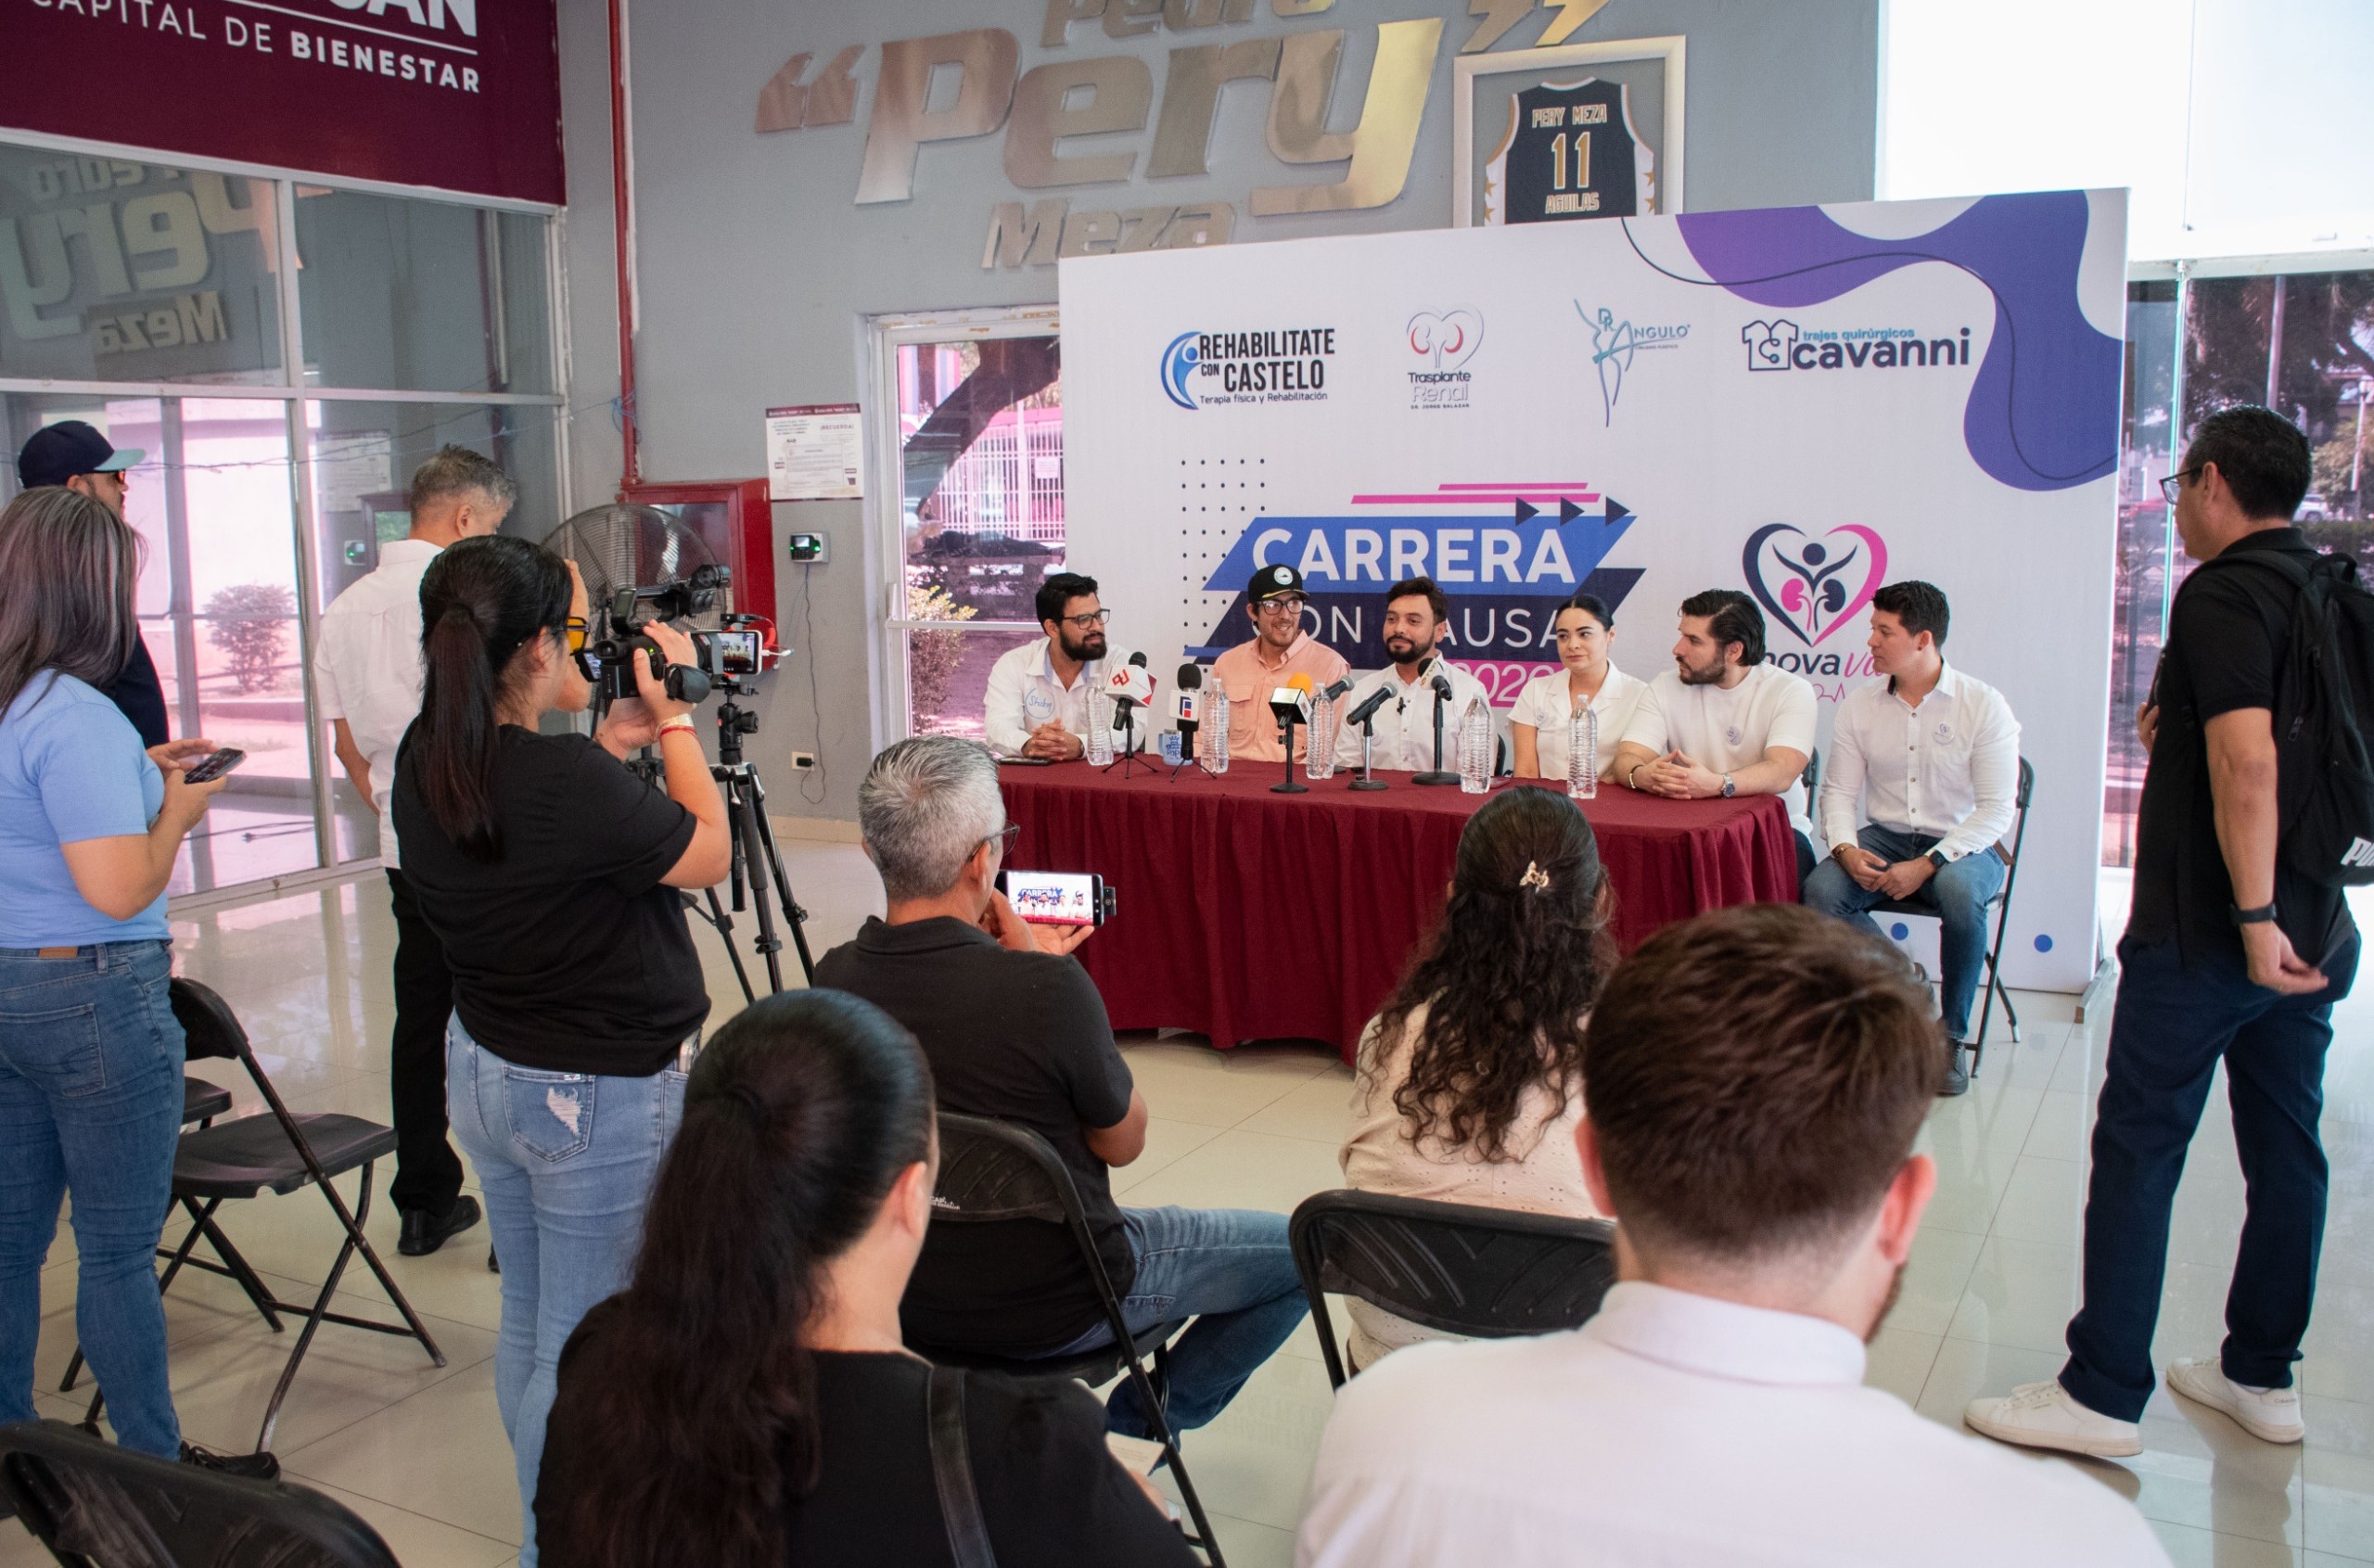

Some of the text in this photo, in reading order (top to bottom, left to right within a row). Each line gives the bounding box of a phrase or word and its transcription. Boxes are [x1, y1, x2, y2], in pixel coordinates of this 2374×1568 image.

[33, 0, 479, 94] PITAL DE BIENESTAR
[1531, 103, 1608, 129] PERY MEZA
[1551, 131, 1591, 189] 11
[1544, 192, 1601, 214] AGUILAS
[981, 198, 1236, 270] Meza
[1199, 327, 1335, 361] REHABILITATE
[1792, 327, 1971, 370] cavanni
[1803, 327, 1915, 342] trajes quirúrgicos
[1201, 359, 1325, 393] CON CASTELO
[1408, 371, 1471, 385] Trasplante
[1412, 383, 1469, 402] Renal
[1200, 391, 1328, 406] Terapia física y Rehabilitación
[1253, 528, 1576, 583] CARRERA
[1252, 605, 1361, 644] ON
